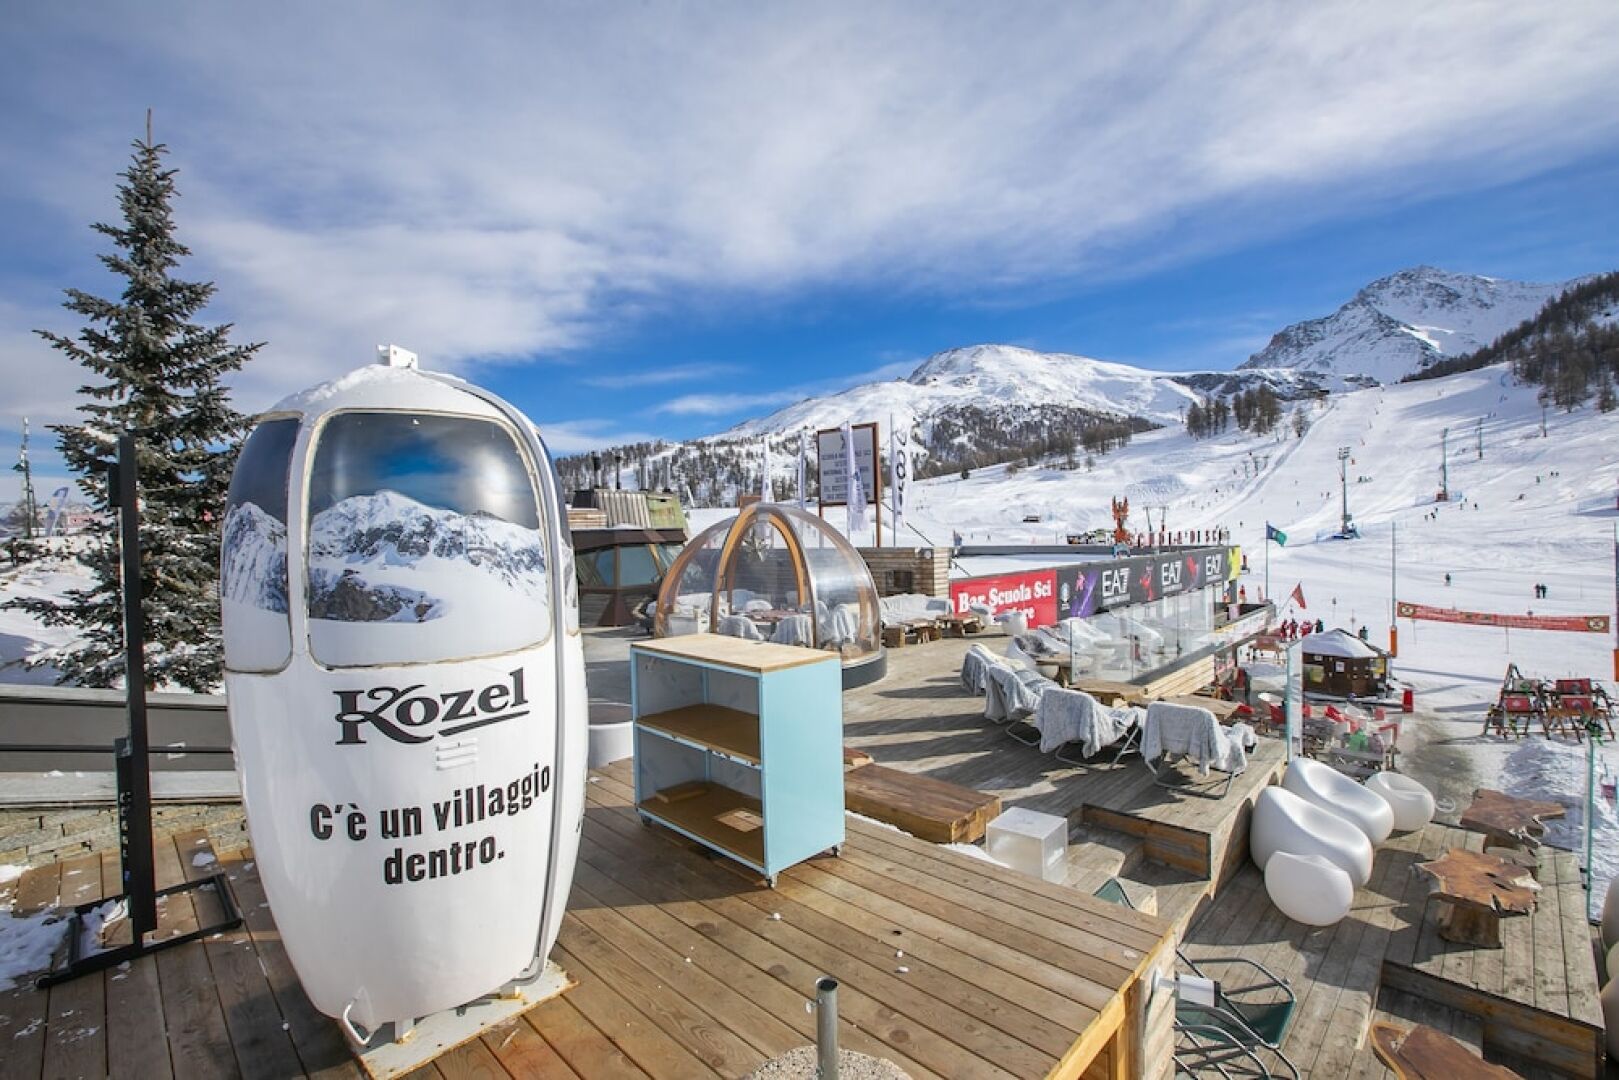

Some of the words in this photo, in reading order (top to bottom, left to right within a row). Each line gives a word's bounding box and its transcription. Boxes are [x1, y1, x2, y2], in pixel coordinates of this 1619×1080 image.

[1102, 567, 1130, 597] EA7
[1162, 561, 1182, 586] EA7
[987, 583, 1032, 608] Scuola
[1034, 580, 1052, 599] Sci
[333, 667, 530, 745] Kozel
[310, 803, 367, 841] C'è
[380, 807, 422, 839] un
[433, 763, 550, 831] villaggio
[384, 835, 505, 885] dentro.
